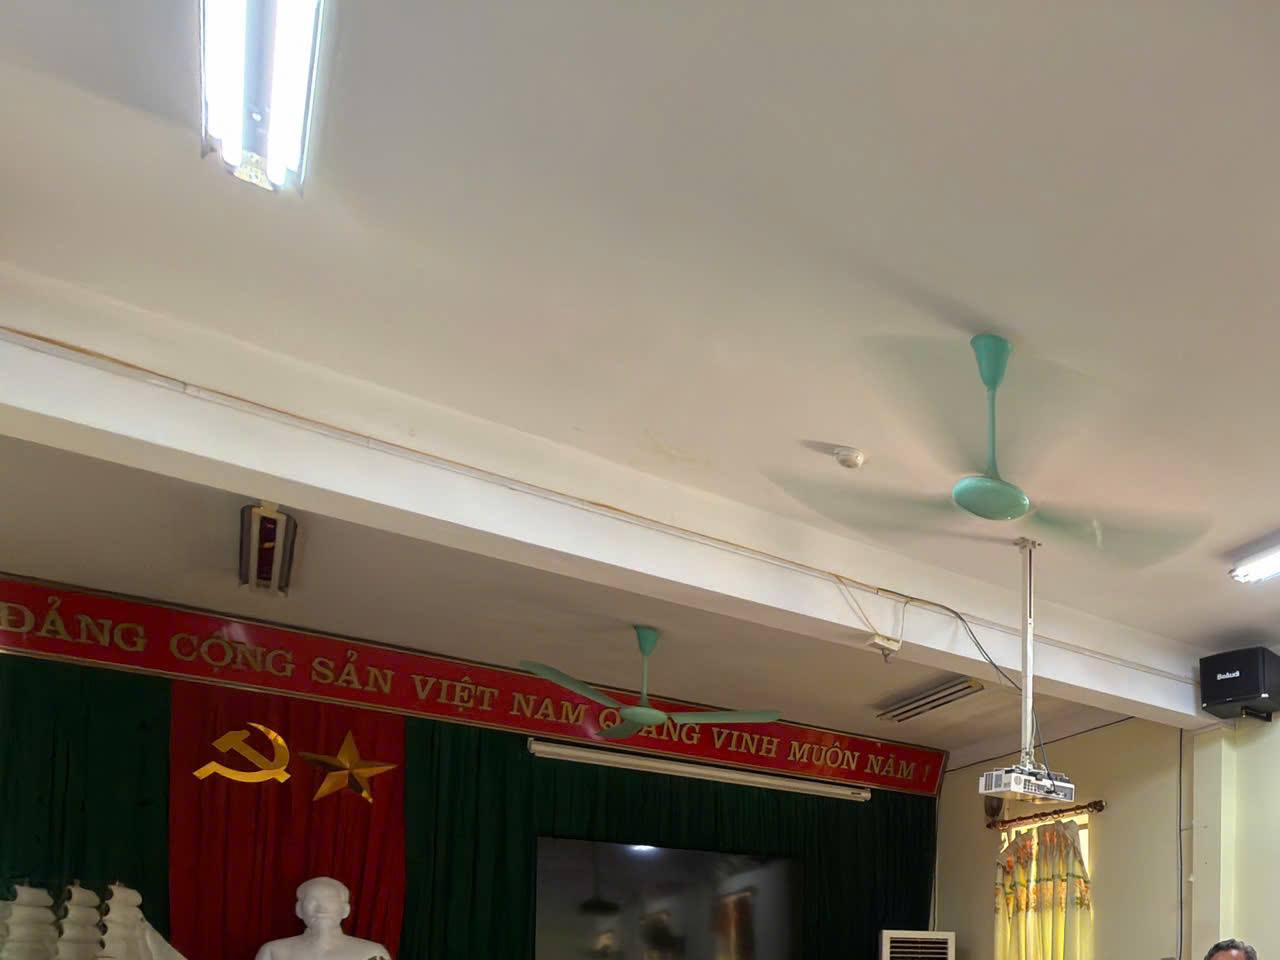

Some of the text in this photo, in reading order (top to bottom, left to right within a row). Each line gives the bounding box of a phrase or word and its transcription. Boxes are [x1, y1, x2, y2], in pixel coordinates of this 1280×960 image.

[0, 596, 147, 652] ĐẢNG
[169, 625, 295, 678] CỘNG
[311, 650, 394, 694] SẢN
[410, 674, 498, 713] VIỆT
[509, 692, 589, 726] NAM
[599, 708, 700, 745] QANG
[711, 727, 781, 758] VINH
[787, 740, 859, 771] MUÔN
[864, 754, 917, 781] NĂM
